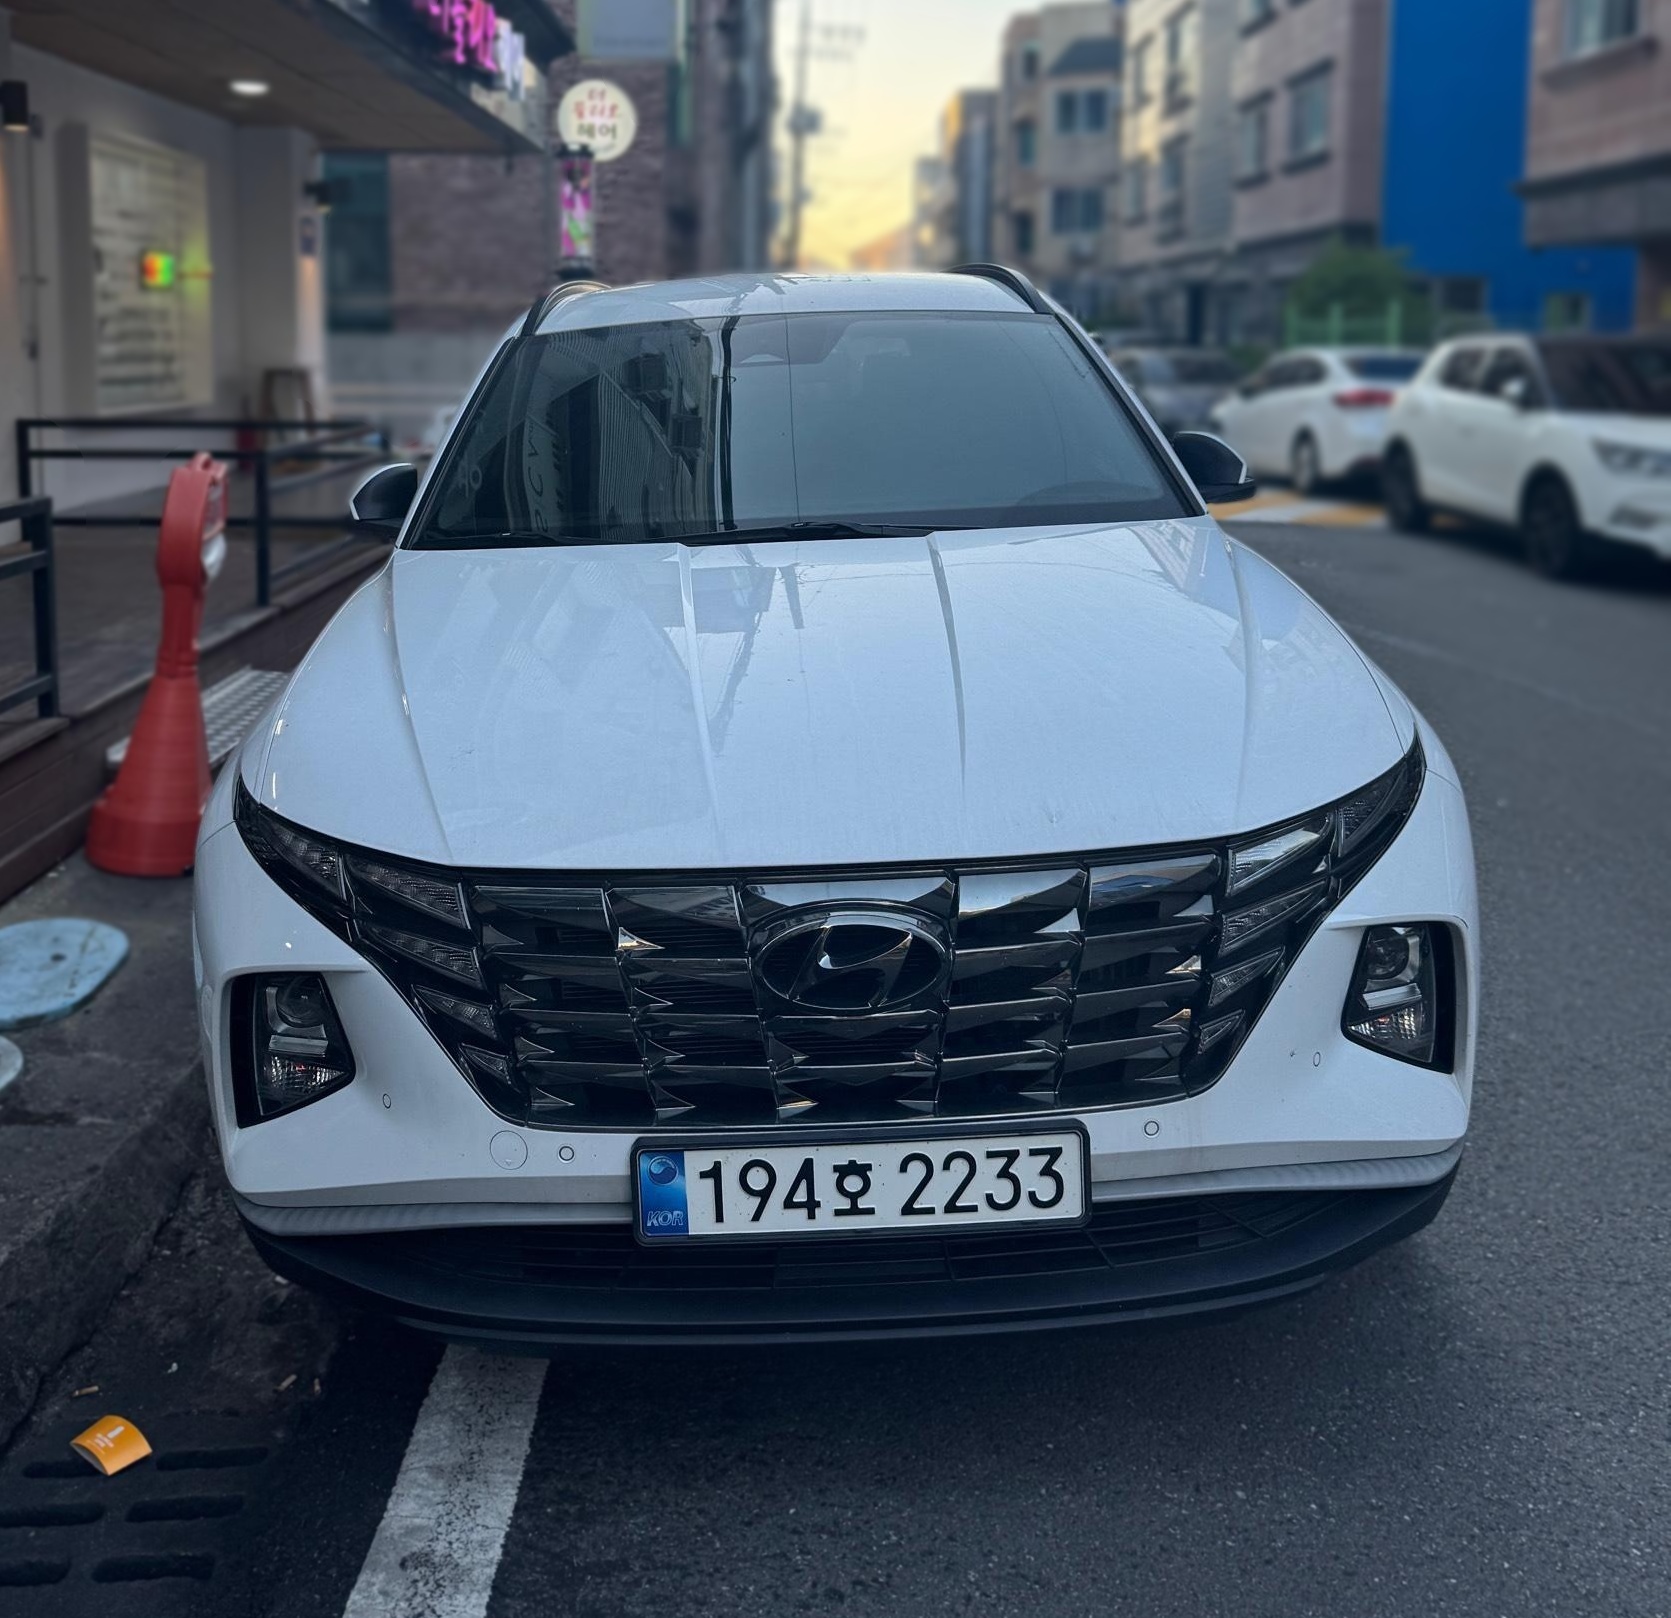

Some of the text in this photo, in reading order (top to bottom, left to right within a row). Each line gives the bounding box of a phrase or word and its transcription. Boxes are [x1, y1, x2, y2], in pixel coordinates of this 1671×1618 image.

[577, 123, 618, 140] 헤어
[698, 1145, 1065, 1224] 194호 2233
[646, 1210, 684, 1227] KOR
